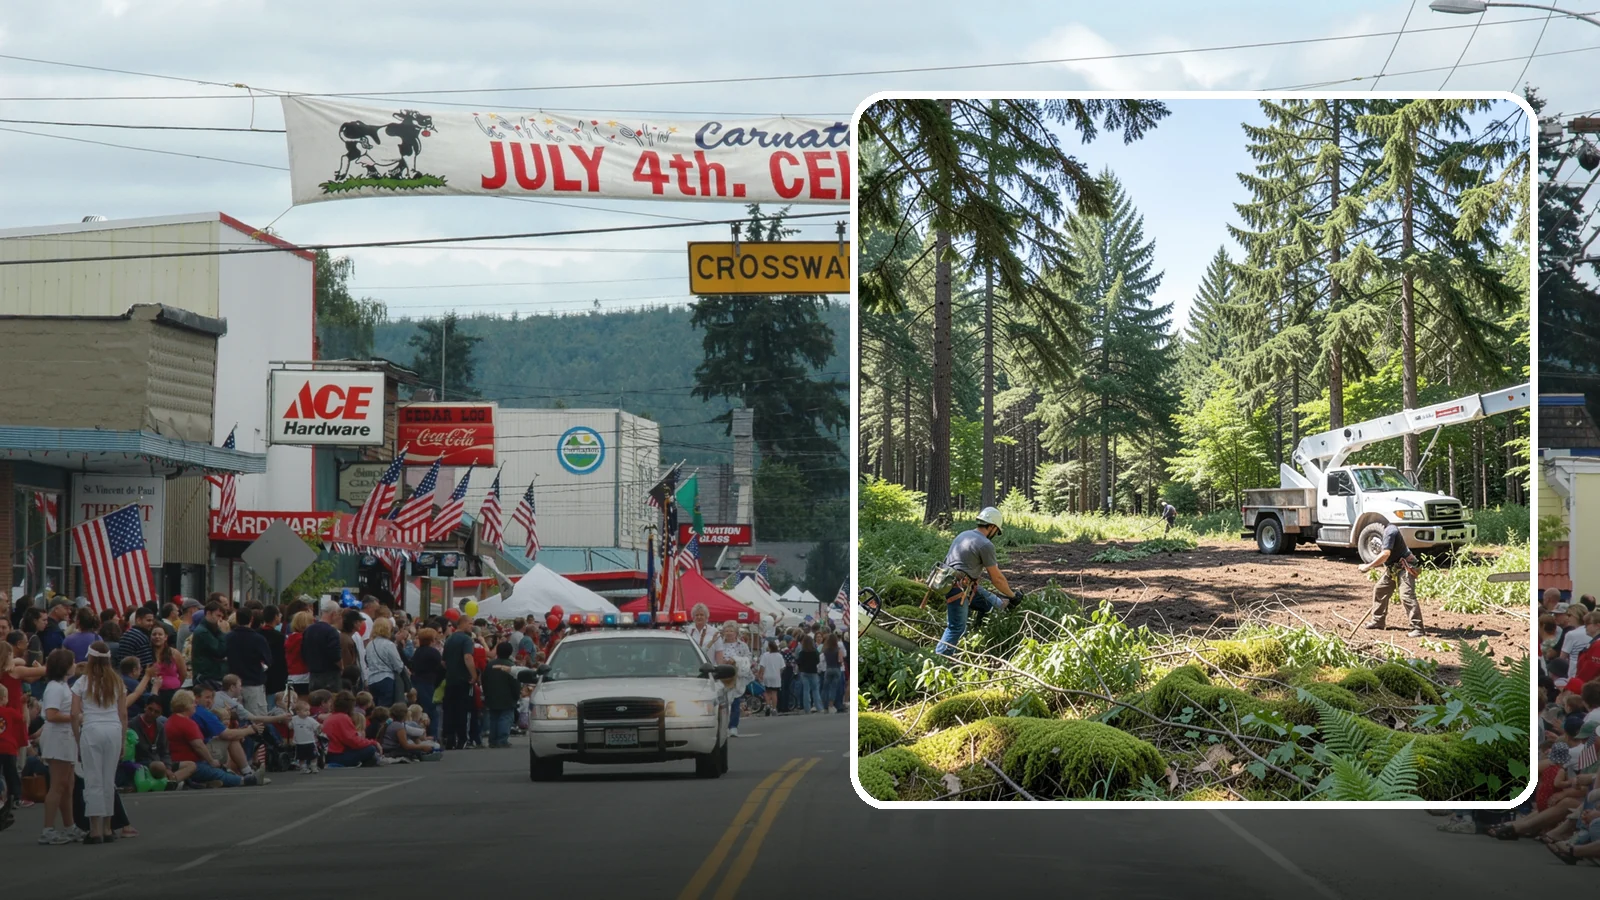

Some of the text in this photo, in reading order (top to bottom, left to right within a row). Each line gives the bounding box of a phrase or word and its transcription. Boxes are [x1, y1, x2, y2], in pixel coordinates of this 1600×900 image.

[694, 121, 850, 150] Carnat
[481, 141, 605, 192] JULY
[632, 150, 746, 198] 4th.
[697, 254, 850, 280] CROSSWA
[283, 380, 373, 419] ACE
[405, 409, 452, 422] CEDAR
[283, 421, 371, 437] Hardware
[416, 428, 477, 446] Coca-Cola
[354, 467, 383, 478] Simpl
[83, 485, 155, 495] St. Vincent de Paul
[81, 503, 153, 522] THT
[688, 527, 741, 535] CRNATION
[699, 535, 730, 543] GLASS
